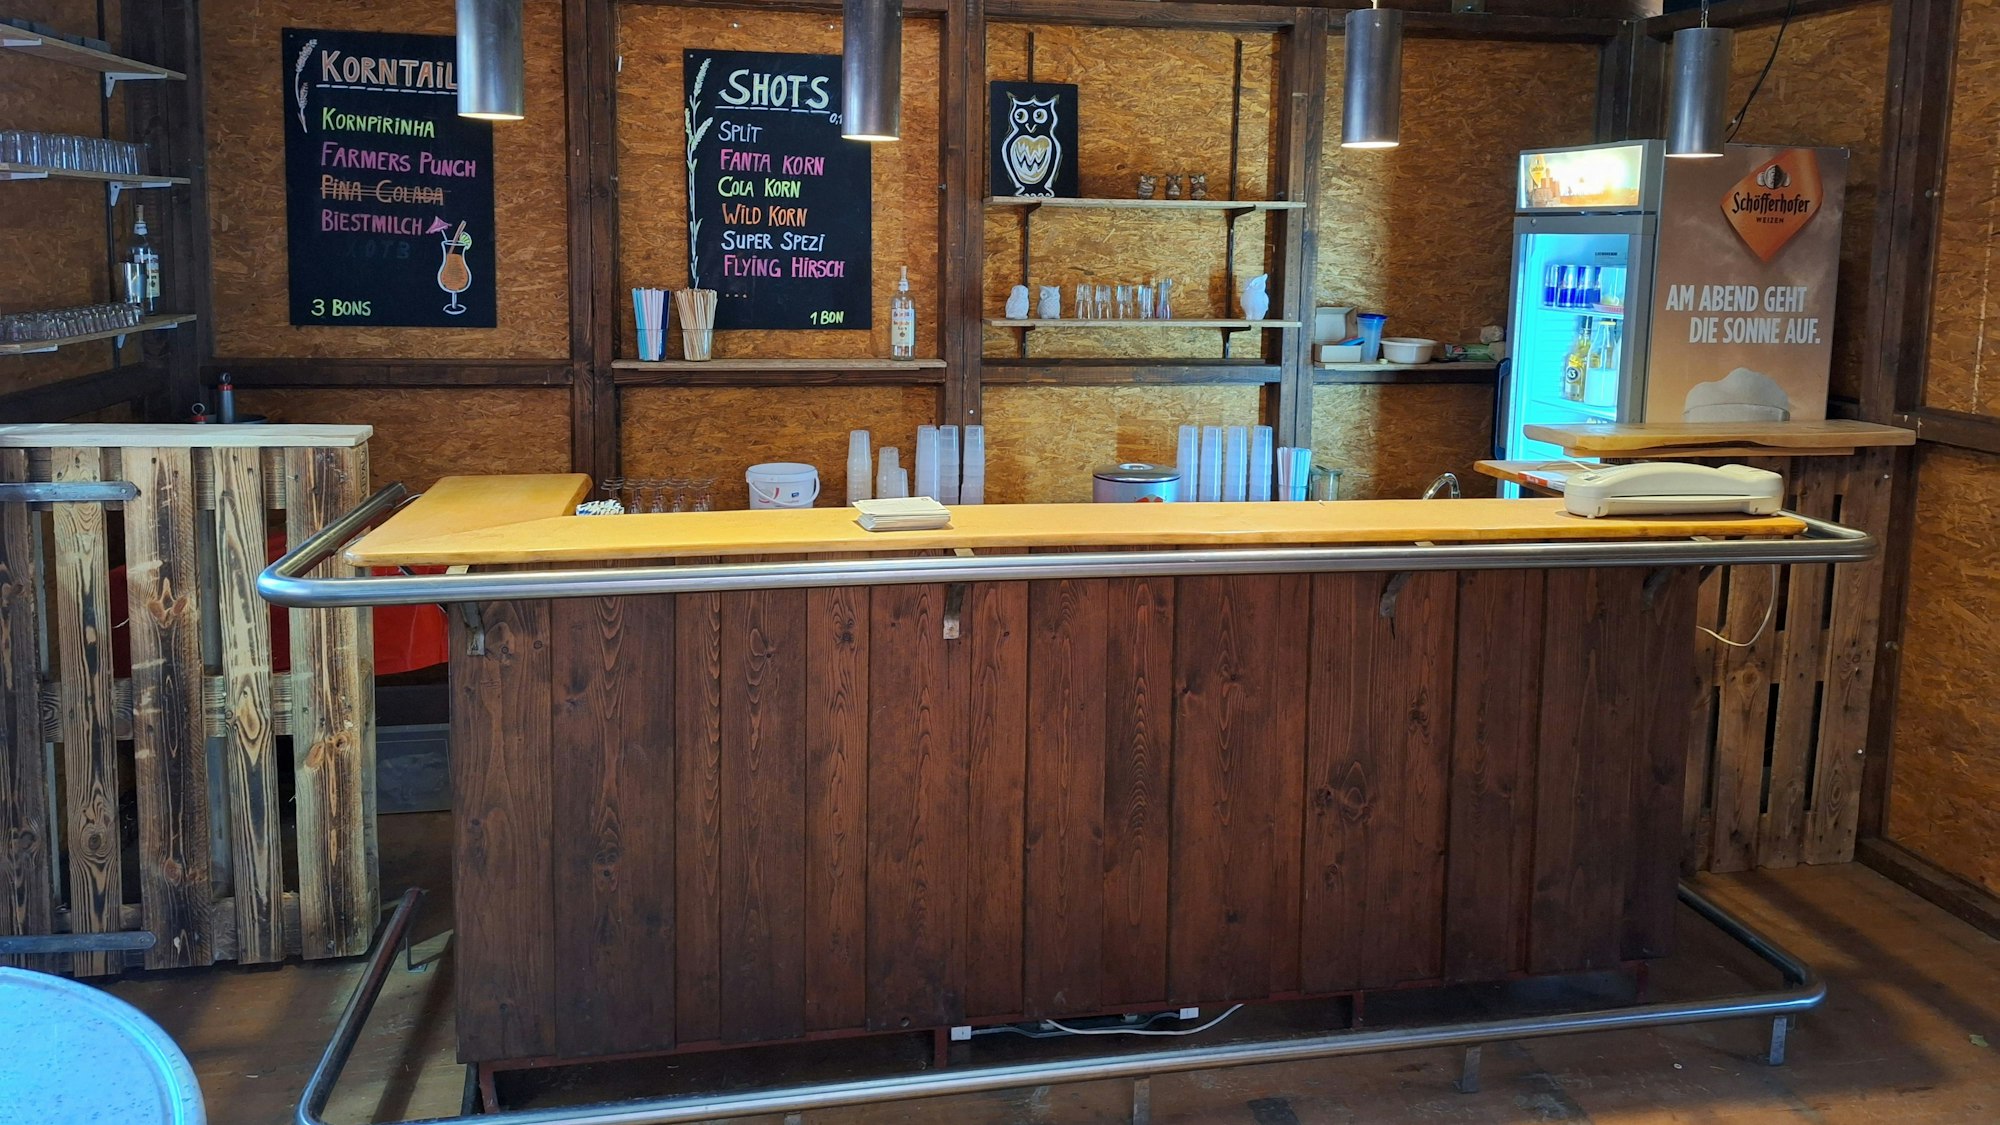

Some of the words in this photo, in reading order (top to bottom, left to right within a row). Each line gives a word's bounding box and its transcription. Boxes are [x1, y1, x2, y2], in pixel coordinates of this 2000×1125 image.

[718, 69, 830, 110] SHOTS
[322, 107, 435, 139] KORNPIRINHA
[718, 120, 762, 143] SPLIT
[320, 142, 411, 173] FARMERS
[419, 151, 476, 178] PUNCH
[720, 149, 771, 173] FANTA
[782, 155, 825, 176] KORN
[717, 176, 754, 198] COLA
[764, 178, 801, 198] KORN
[722, 203, 762, 226] WILD
[769, 205, 807, 227] KORN
[1732, 191, 1811, 215] Schöfferhofer
[321, 208, 422, 236] BIESTMILCH
[1756, 216, 1785, 224] WEIZEN
[721, 231, 773, 251] SUPER
[780, 231, 826, 252] SPEZI
[723, 254, 781, 277] FLYING
[791, 256, 845, 279] HIRSCH
[310, 299, 325, 317] 3
[332, 299, 372, 317] BONS
[1665, 284, 1695, 312] AM
[1699, 286, 1759, 312] ABEND
[1764, 286, 1807, 313] GEHT
[810, 311, 818, 325] 1
[821, 310, 844, 324] BON
[1689, 317, 1717, 344] DIE
[1722, 317, 1780, 344] SONNE
[1784, 319, 1821, 344] AUF.
